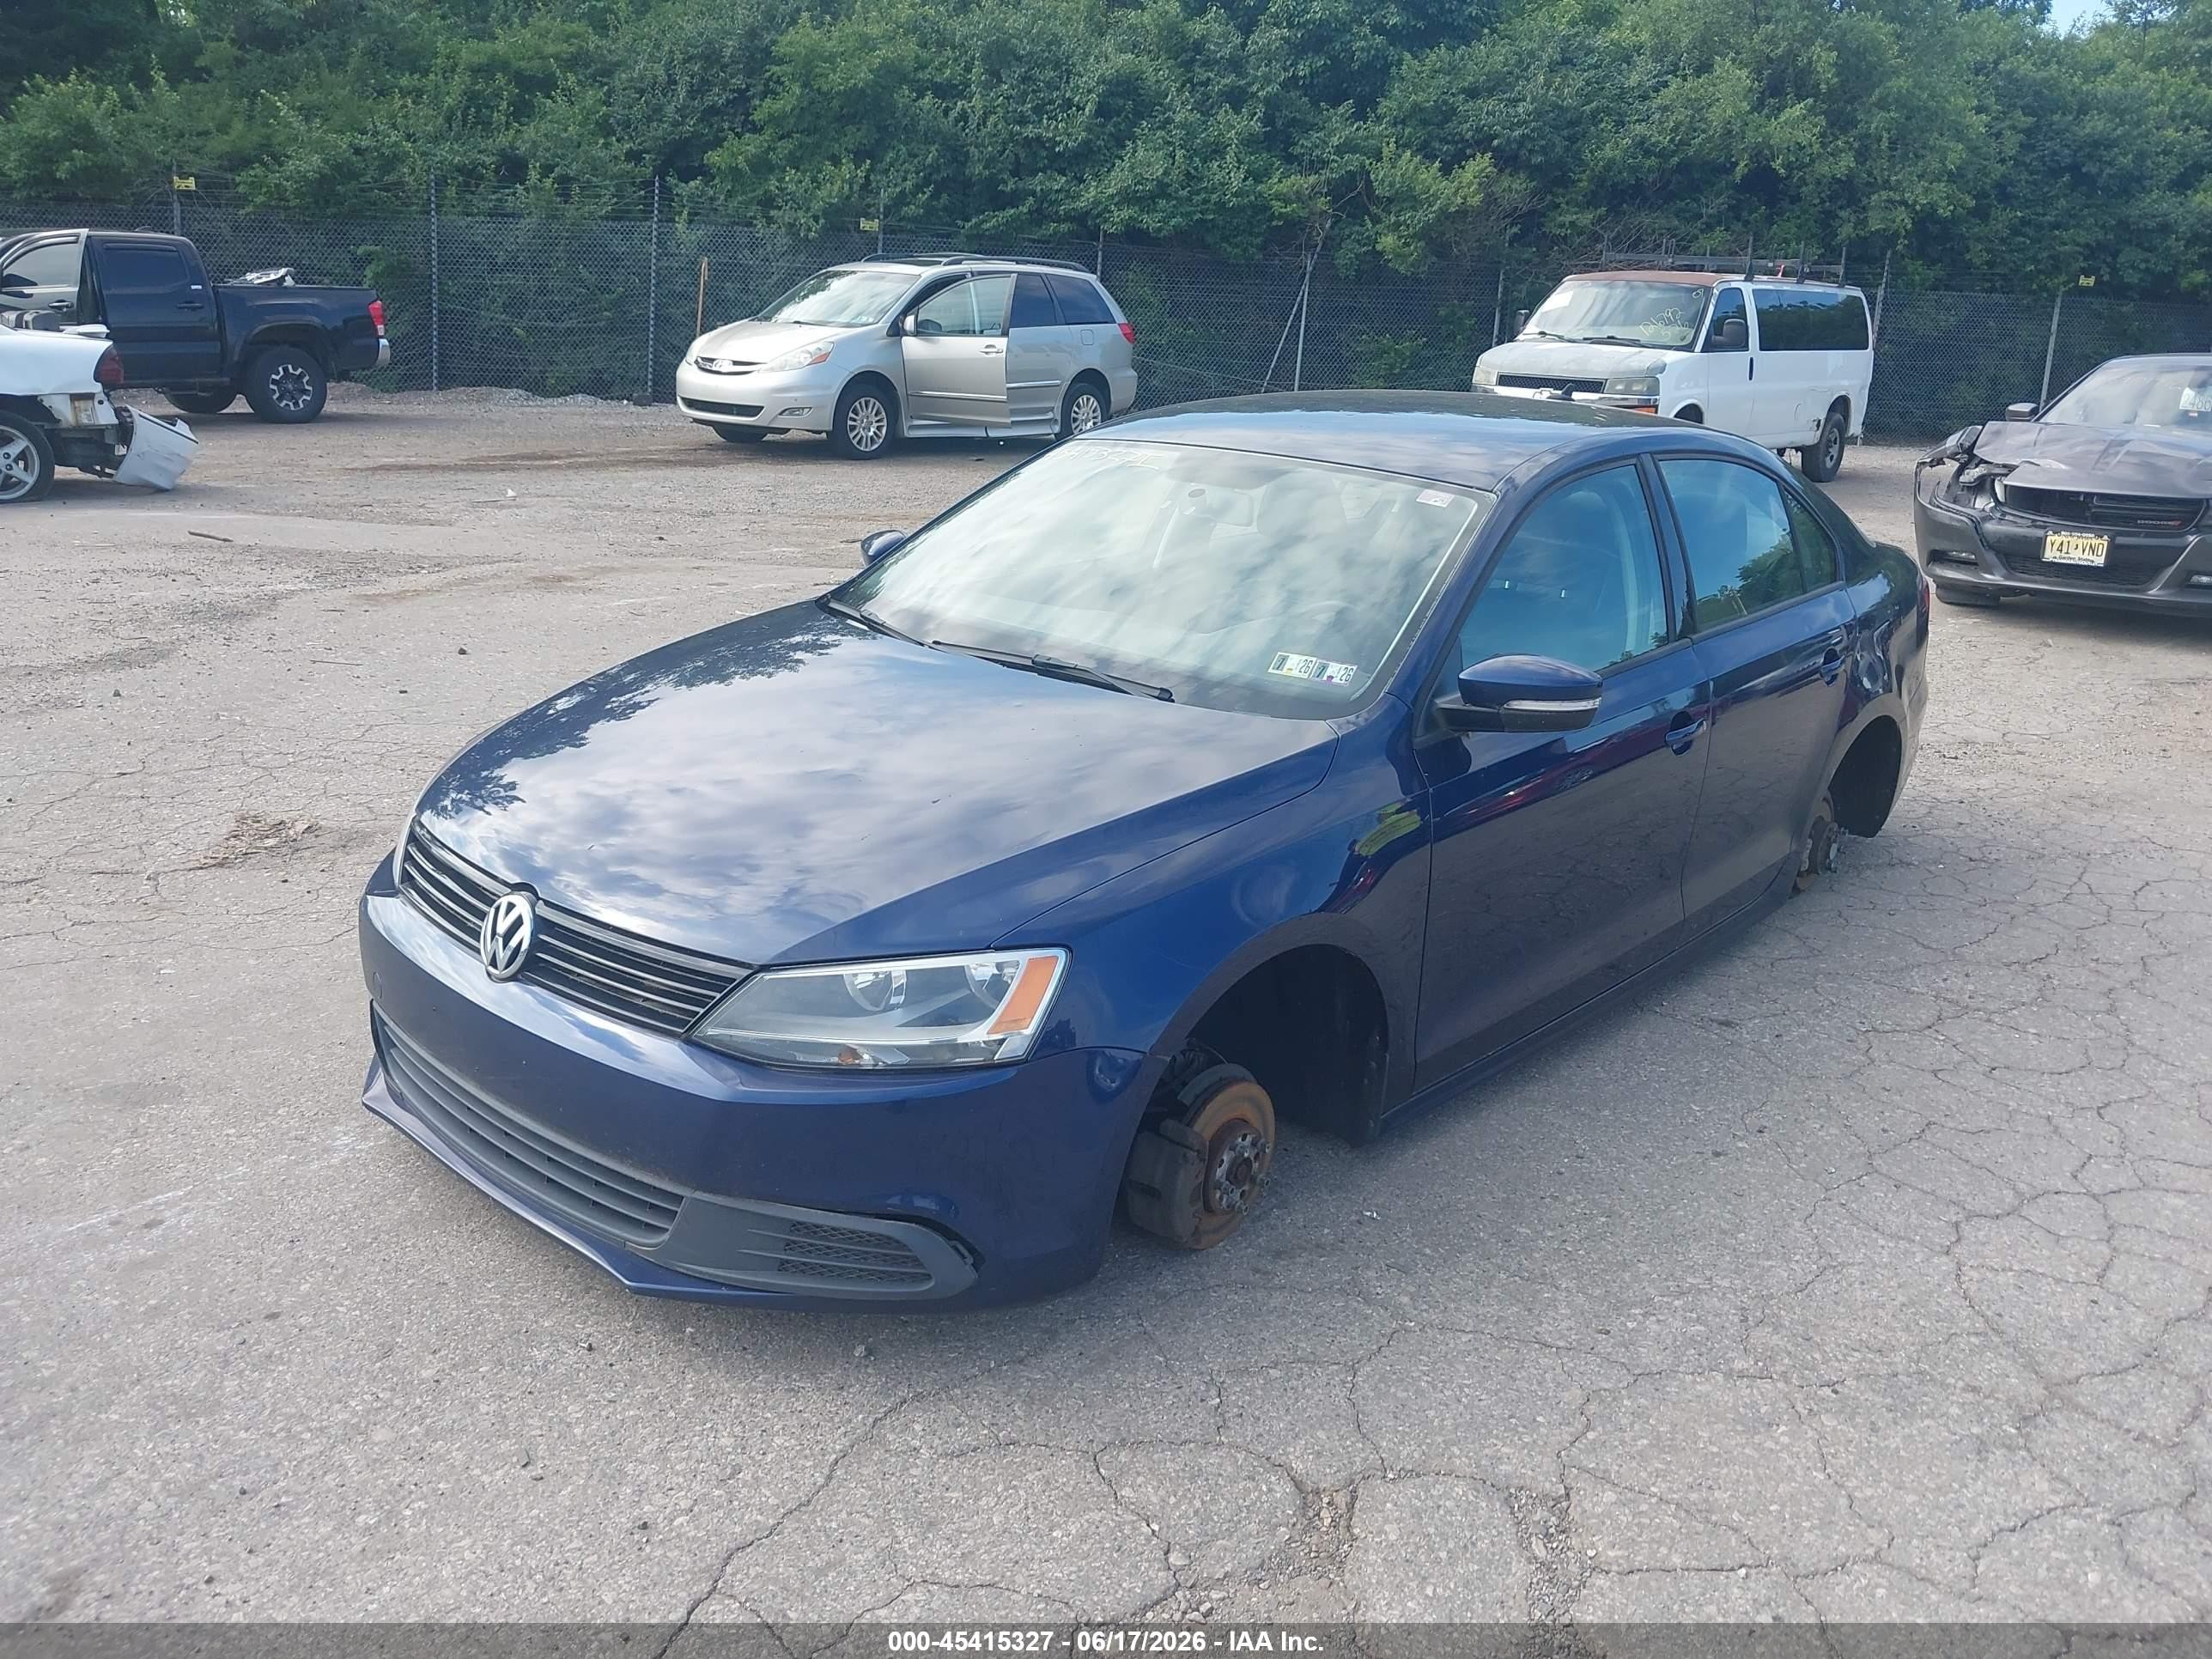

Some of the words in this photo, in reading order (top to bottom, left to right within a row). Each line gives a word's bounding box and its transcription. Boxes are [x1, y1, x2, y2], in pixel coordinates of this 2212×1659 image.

[2050, 538, 2071, 555] Y41
[2081, 541, 2106, 557] VND
[1298, 659, 1314, 675] 26
[1340, 666, 1354, 682] 26
